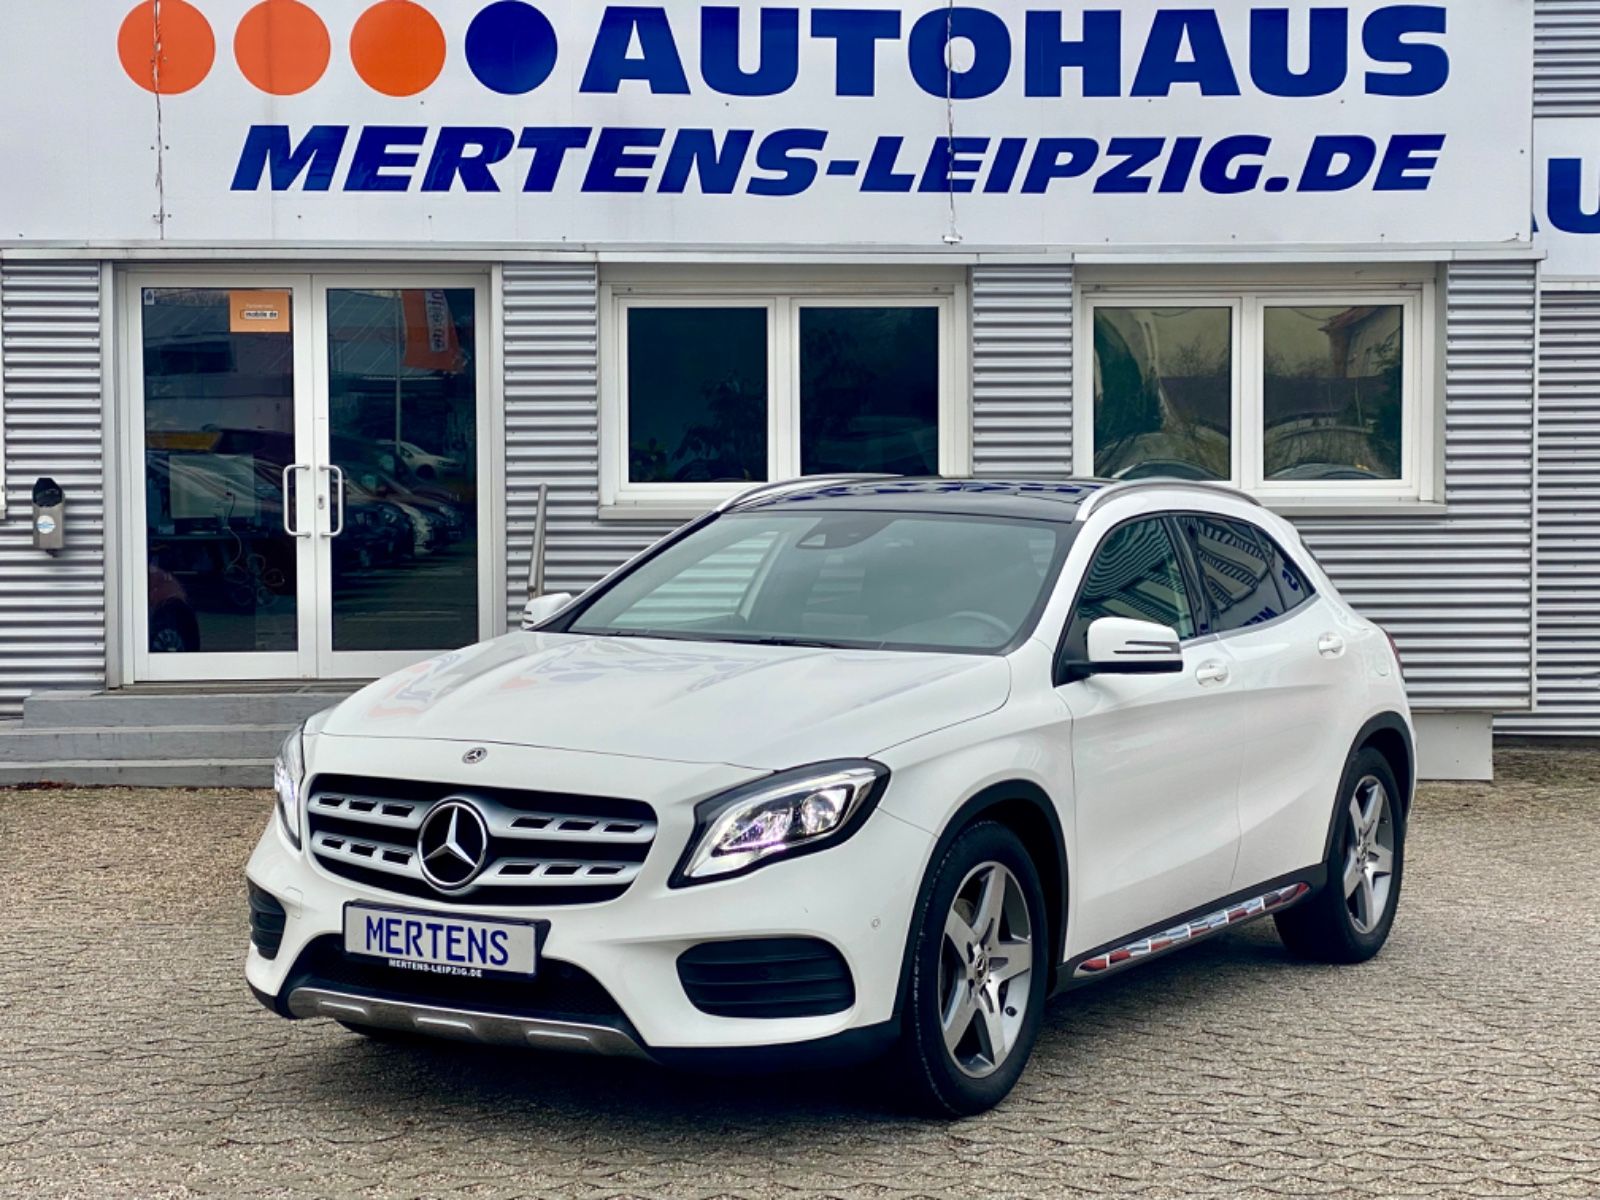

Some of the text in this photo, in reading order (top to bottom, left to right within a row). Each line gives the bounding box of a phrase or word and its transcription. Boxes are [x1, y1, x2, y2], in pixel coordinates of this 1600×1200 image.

[579, 4, 1450, 99] AUTOHAUS
[230, 124, 1446, 197] MERTENS-LEIPZIG.DE
[1532, 157, 1600, 234] U
[366, 915, 509, 966] MERTENS
[388, 959, 483, 978] MERTENS-LEIPZIG.DE
